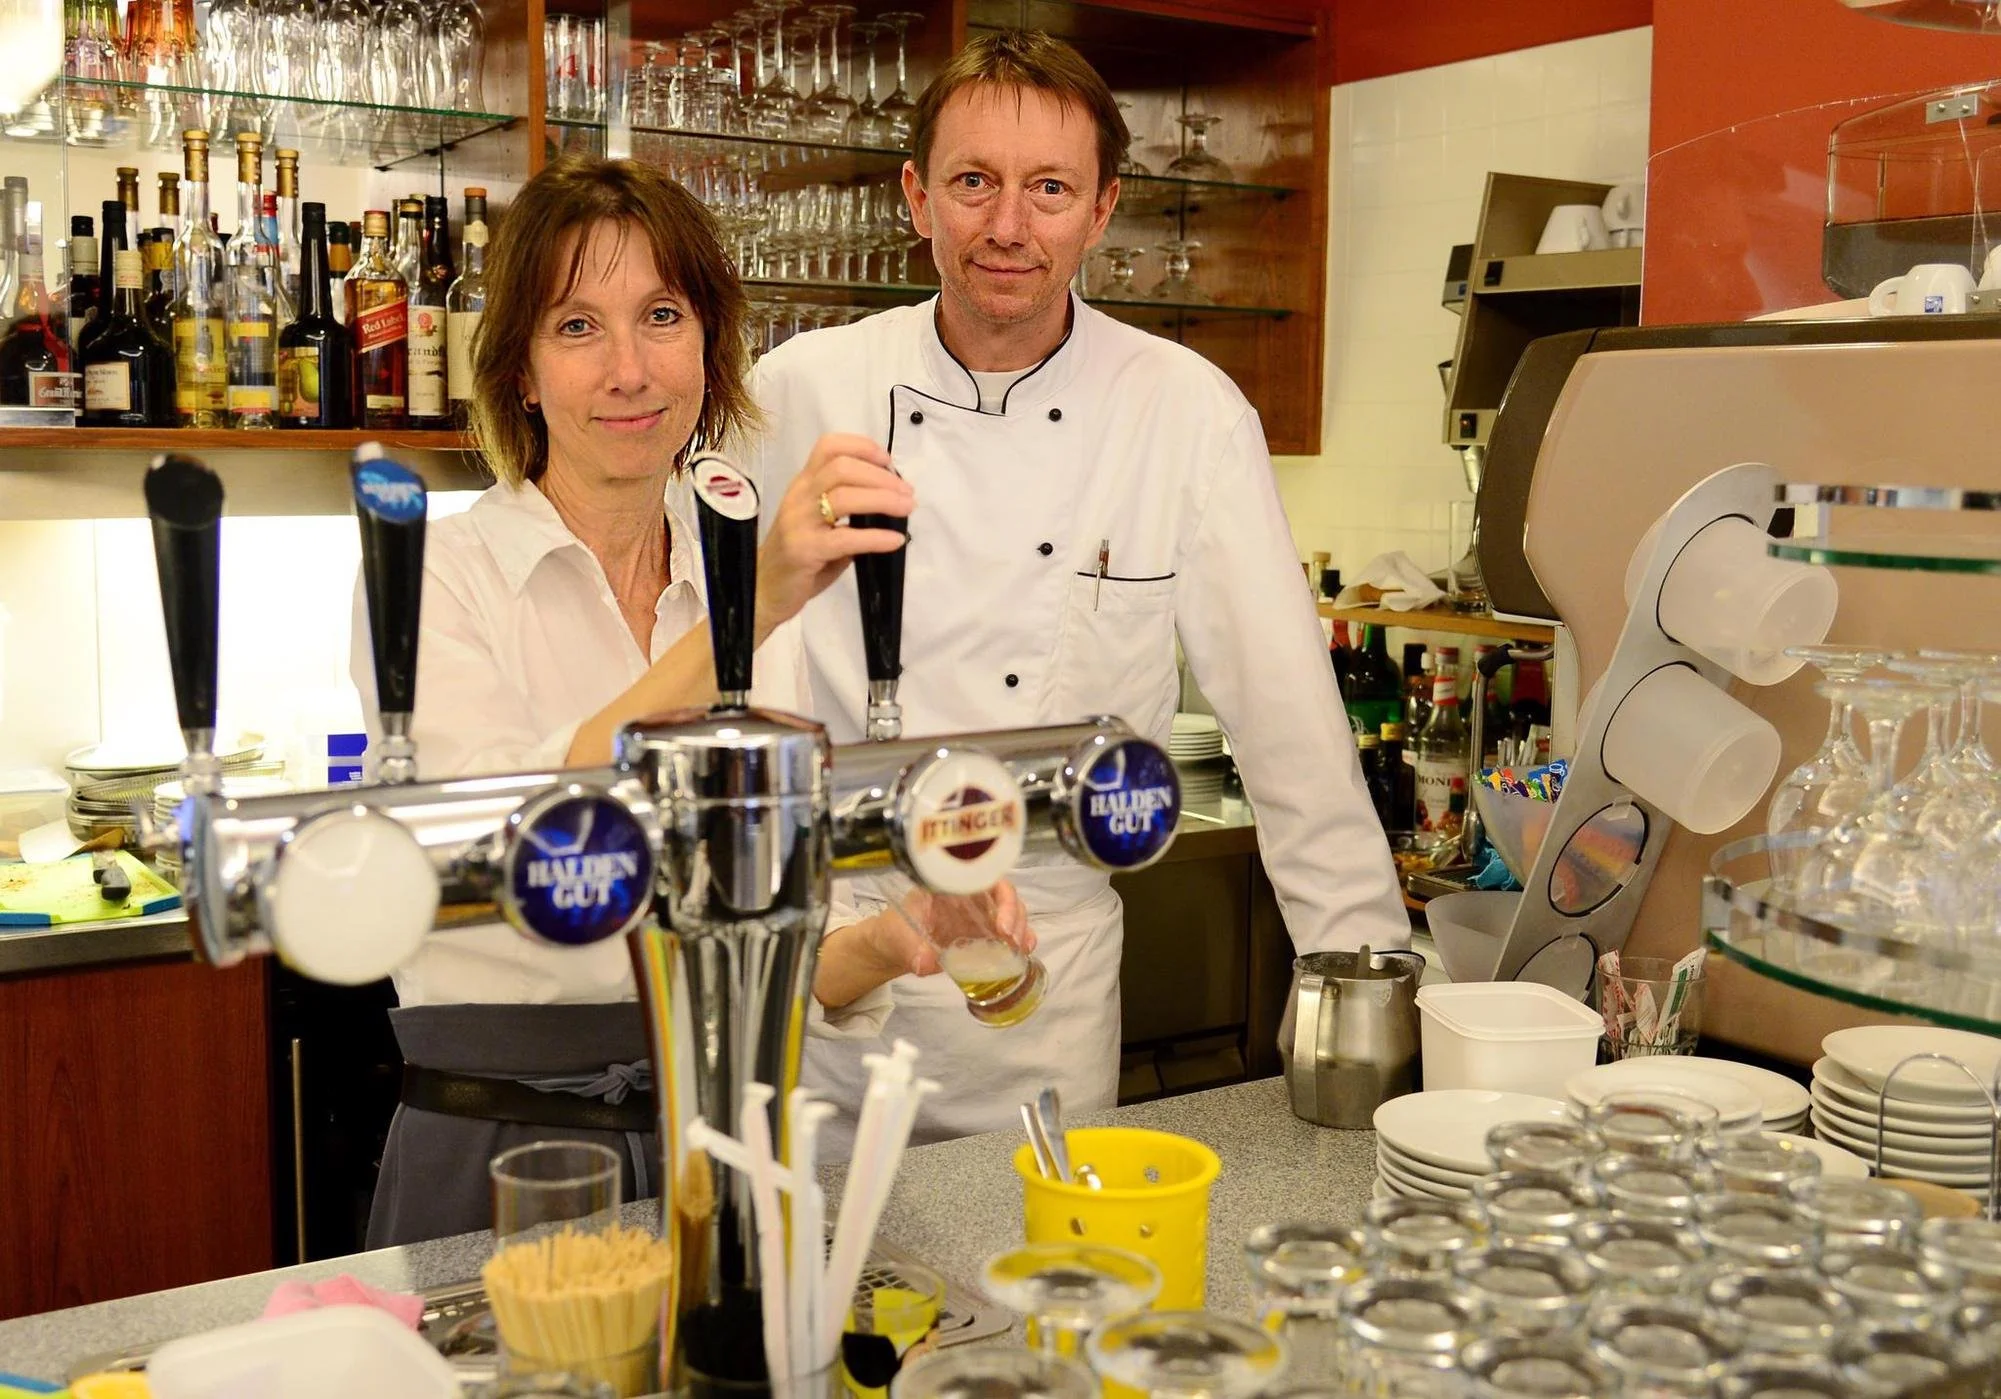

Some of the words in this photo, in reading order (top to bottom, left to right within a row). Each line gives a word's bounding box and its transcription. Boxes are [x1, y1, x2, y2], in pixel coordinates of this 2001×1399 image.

[361, 319, 381, 335] Red
[1416, 774, 1451, 787] MONI
[1089, 785, 1173, 817] HALDEN
[920, 801, 1017, 844] ITTINGER
[1108, 810, 1152, 835] GUT
[527, 851, 639, 888] HALDEN
[552, 877, 612, 910] GUT
